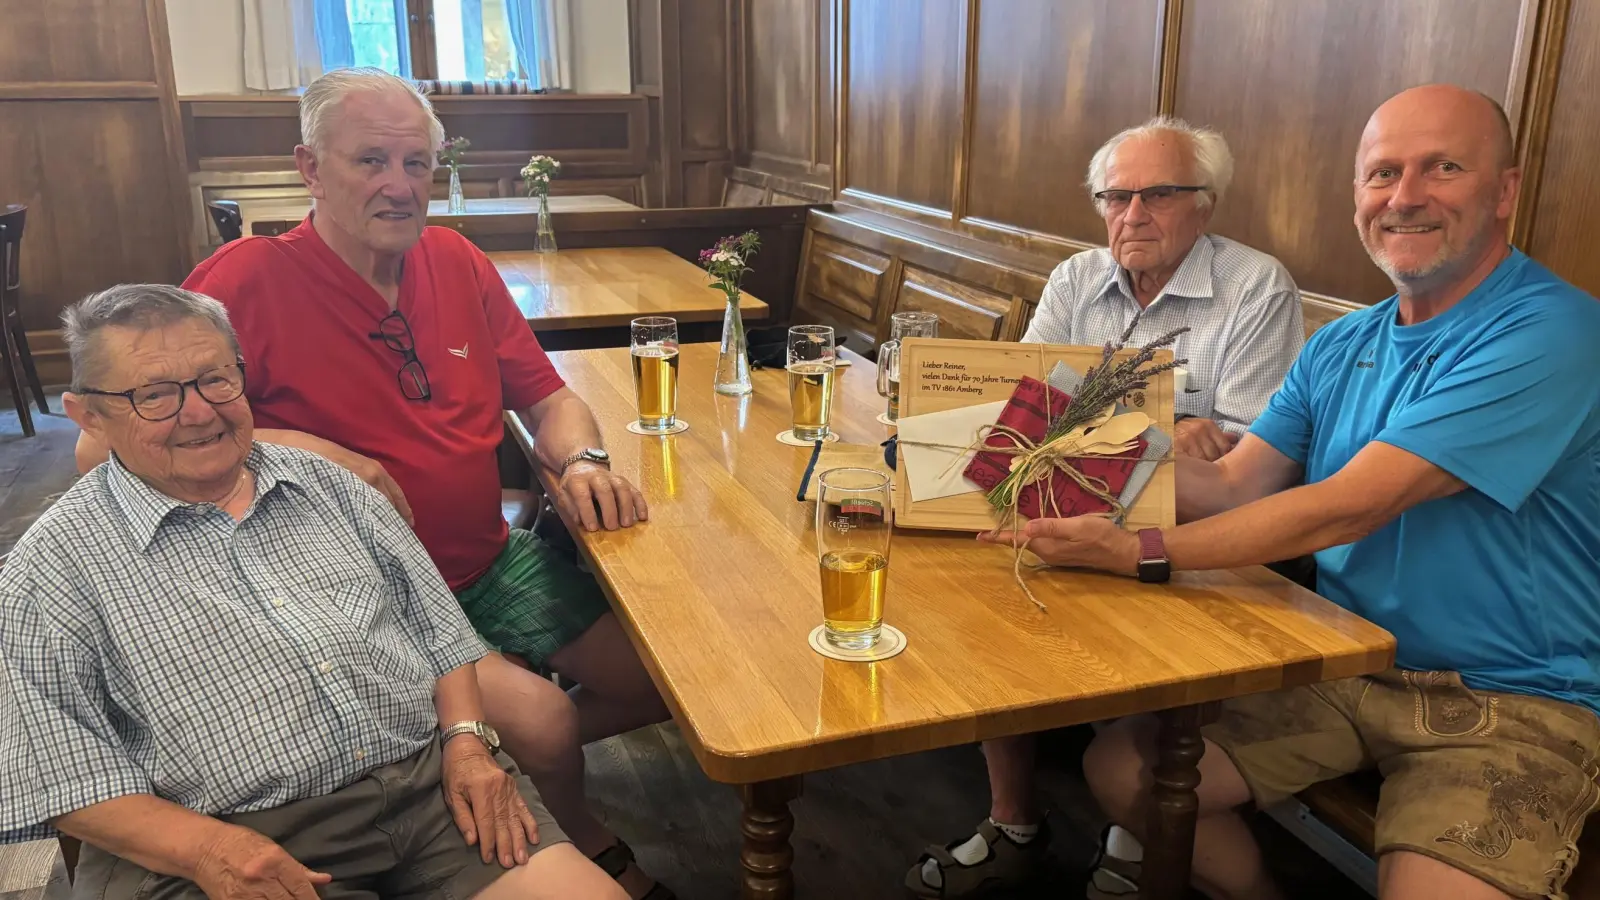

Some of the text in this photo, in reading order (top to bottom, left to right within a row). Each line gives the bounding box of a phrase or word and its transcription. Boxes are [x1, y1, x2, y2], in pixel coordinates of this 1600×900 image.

[922, 361, 966, 371] Lieber Reiner,
[922, 372, 940, 380] vielen
[942, 373, 960, 381] Dank
[960, 374, 971, 384] für
[980, 374, 998, 384] Jahre
[956, 385, 983, 395] Amberg
